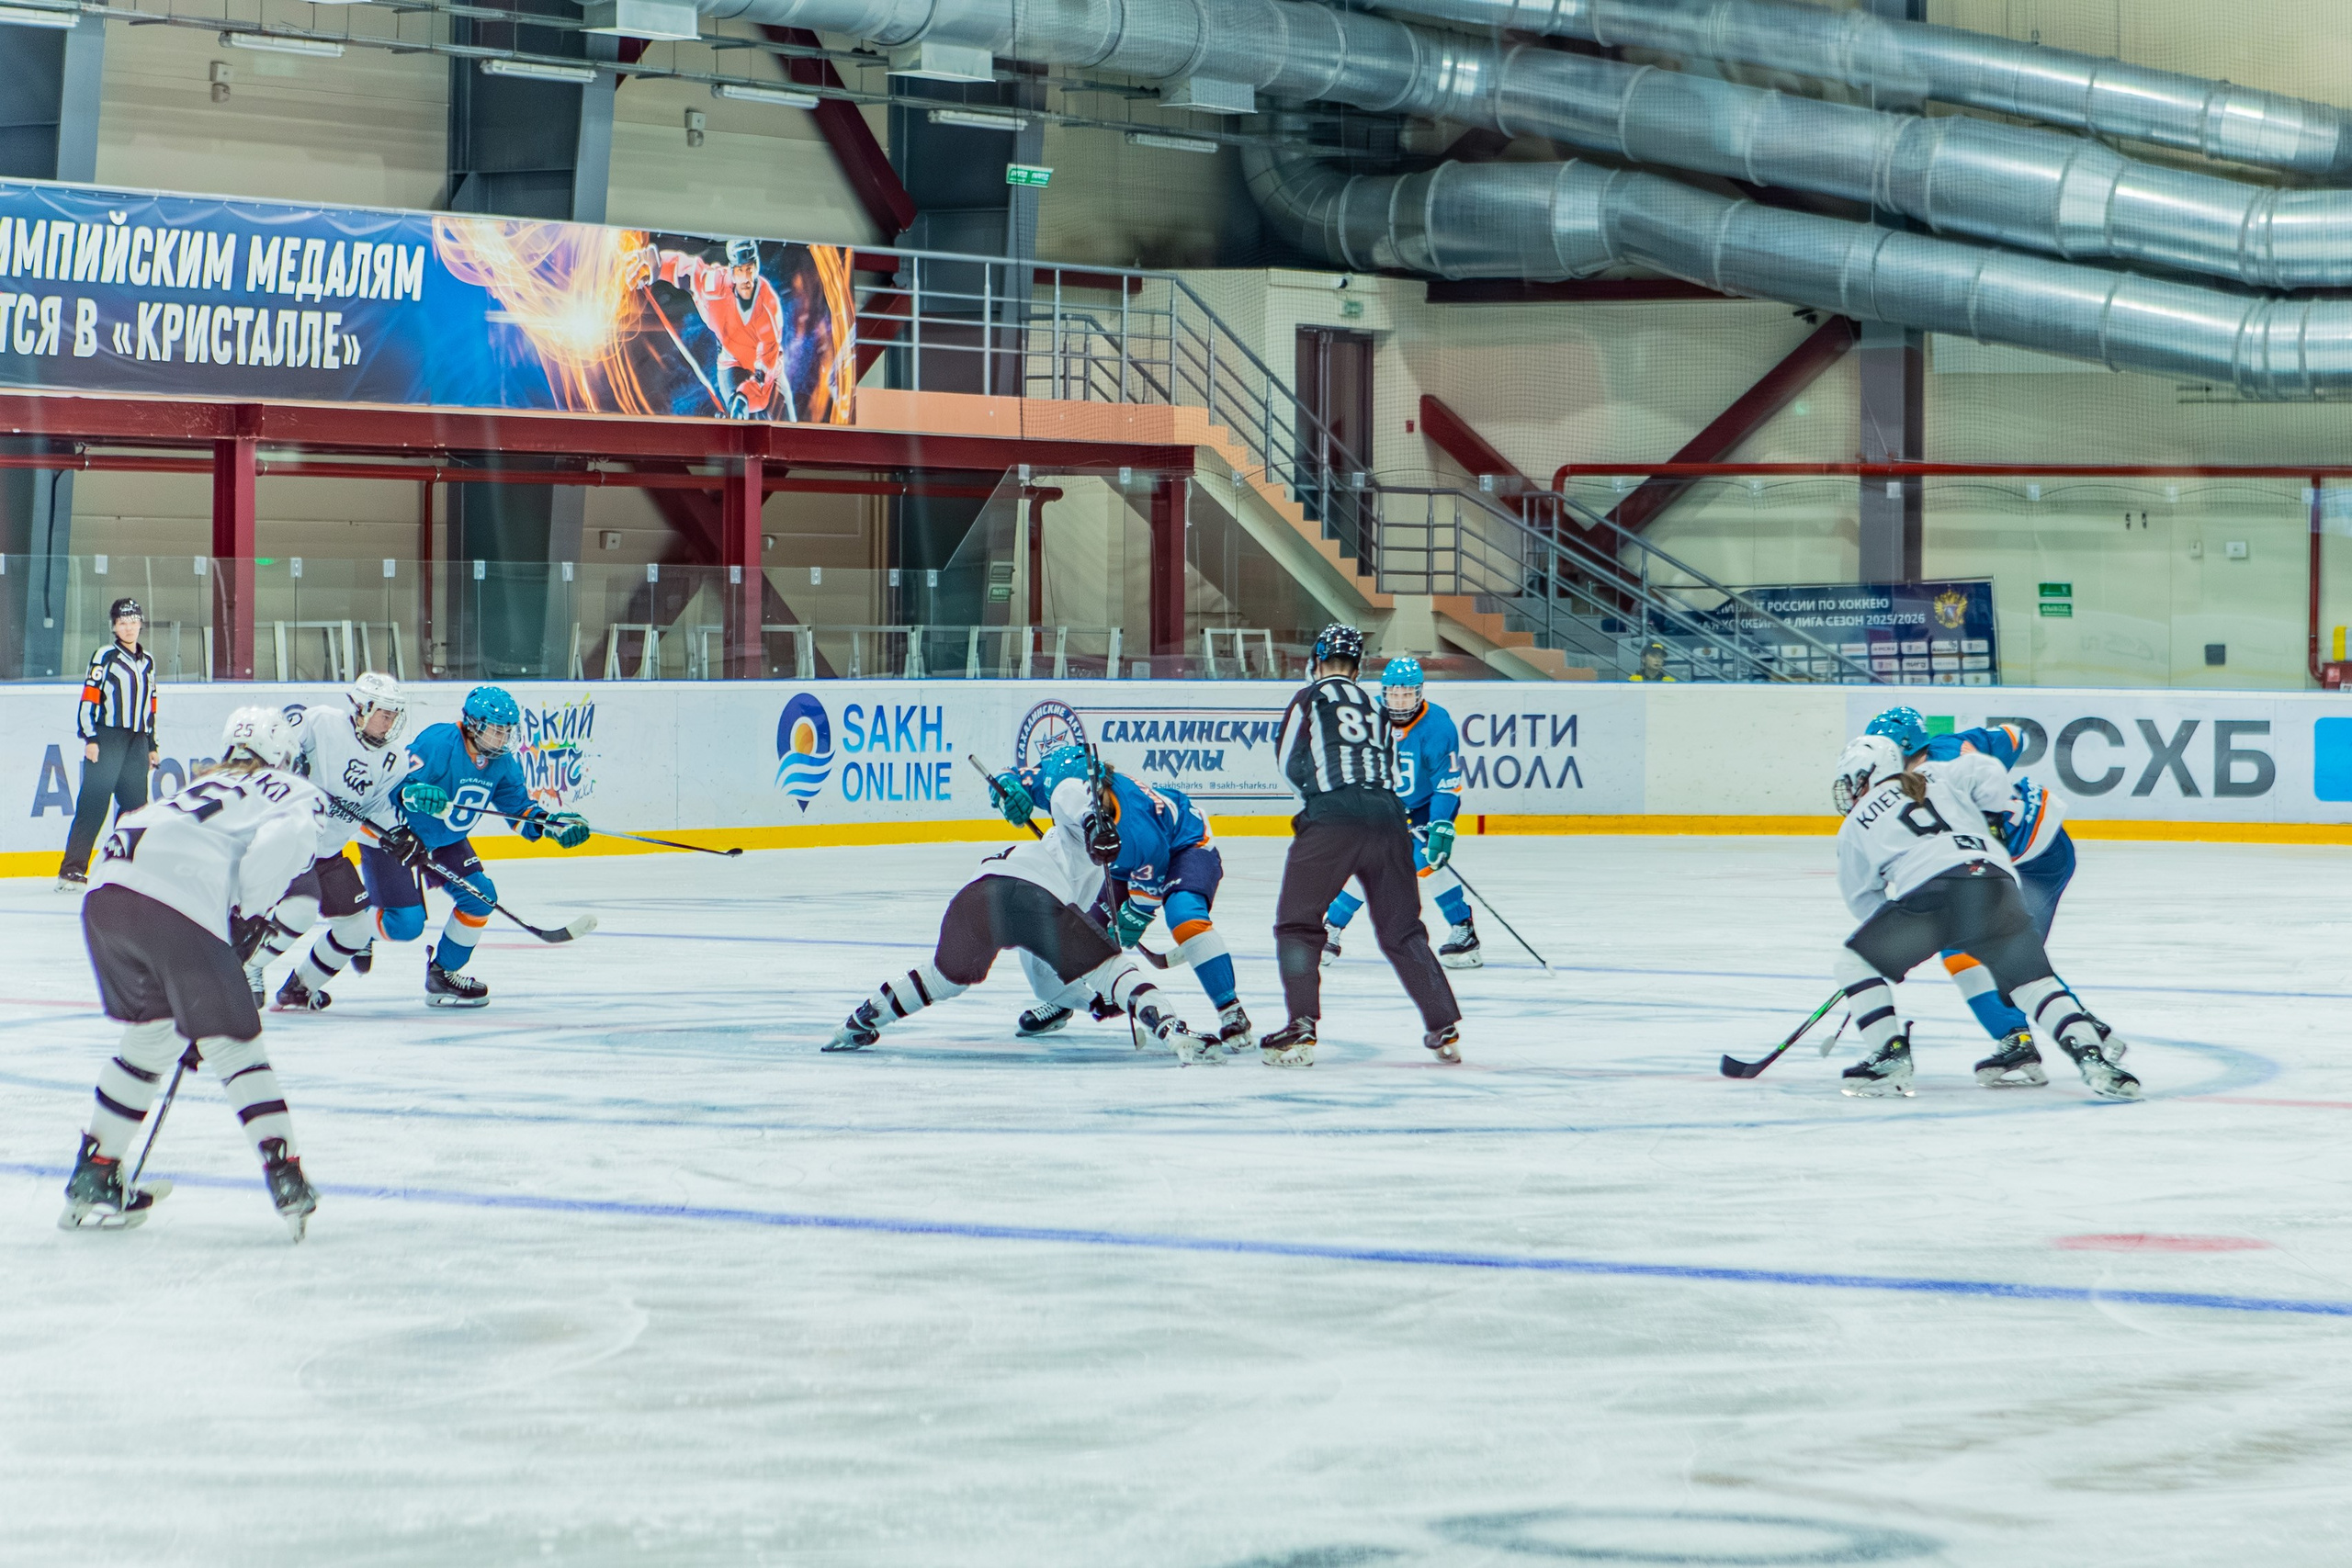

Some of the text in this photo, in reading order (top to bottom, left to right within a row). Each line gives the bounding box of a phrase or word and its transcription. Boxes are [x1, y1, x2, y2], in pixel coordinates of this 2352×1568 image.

[246, 235, 425, 303] МЕДАЛЯМ
[74, 298, 98, 358] В
[112, 301, 361, 370] «КРИСТАЛЛЕ»
[1768, 600, 1815, 612] РОССИИ
[1818, 600, 1836, 611] ПО
[1838, 598, 1890, 610] ХОККЕЮ
[1794, 616, 1823, 628] ЛИГА
[1826, 615, 1864, 626] СЕЗОН
[1866, 613, 1926, 626] 2025/2026
[234, 723, 254, 738] 25
[519, 701, 595, 742] РКИЙ
[842, 703, 954, 753] SAKH.
[1335, 705, 1385, 751] 81
[1461, 714, 1578, 749] СИТИ
[383, 751, 397, 773] A
[1142, 749, 1225, 779] АКУЛЫ
[1457, 755, 1584, 790] МОЛЛ
[1984, 716, 2277, 798] РСХБ
[842, 760, 953, 803] ONLINE
